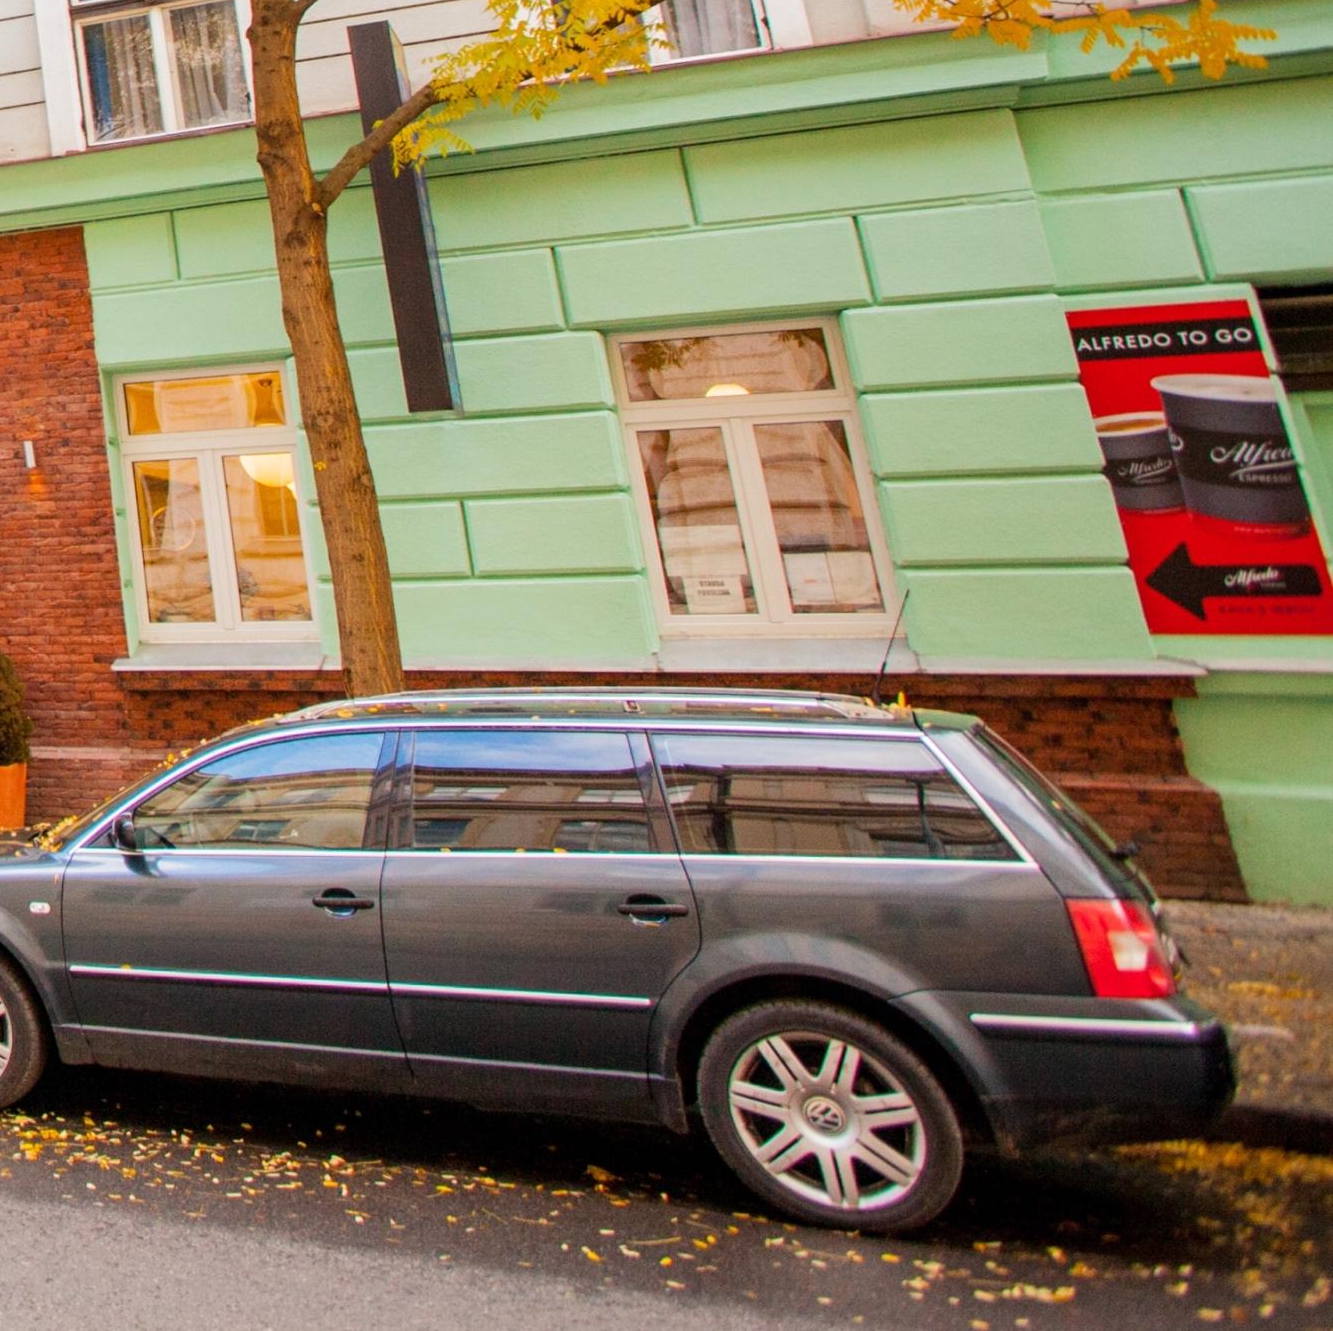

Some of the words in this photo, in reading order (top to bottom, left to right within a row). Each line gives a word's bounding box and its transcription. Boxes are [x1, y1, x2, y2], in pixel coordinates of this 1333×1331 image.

[1077, 332, 1171, 352] ALFREDO
[1177, 330, 1208, 346] TO
[1215, 327, 1252, 344] GO
